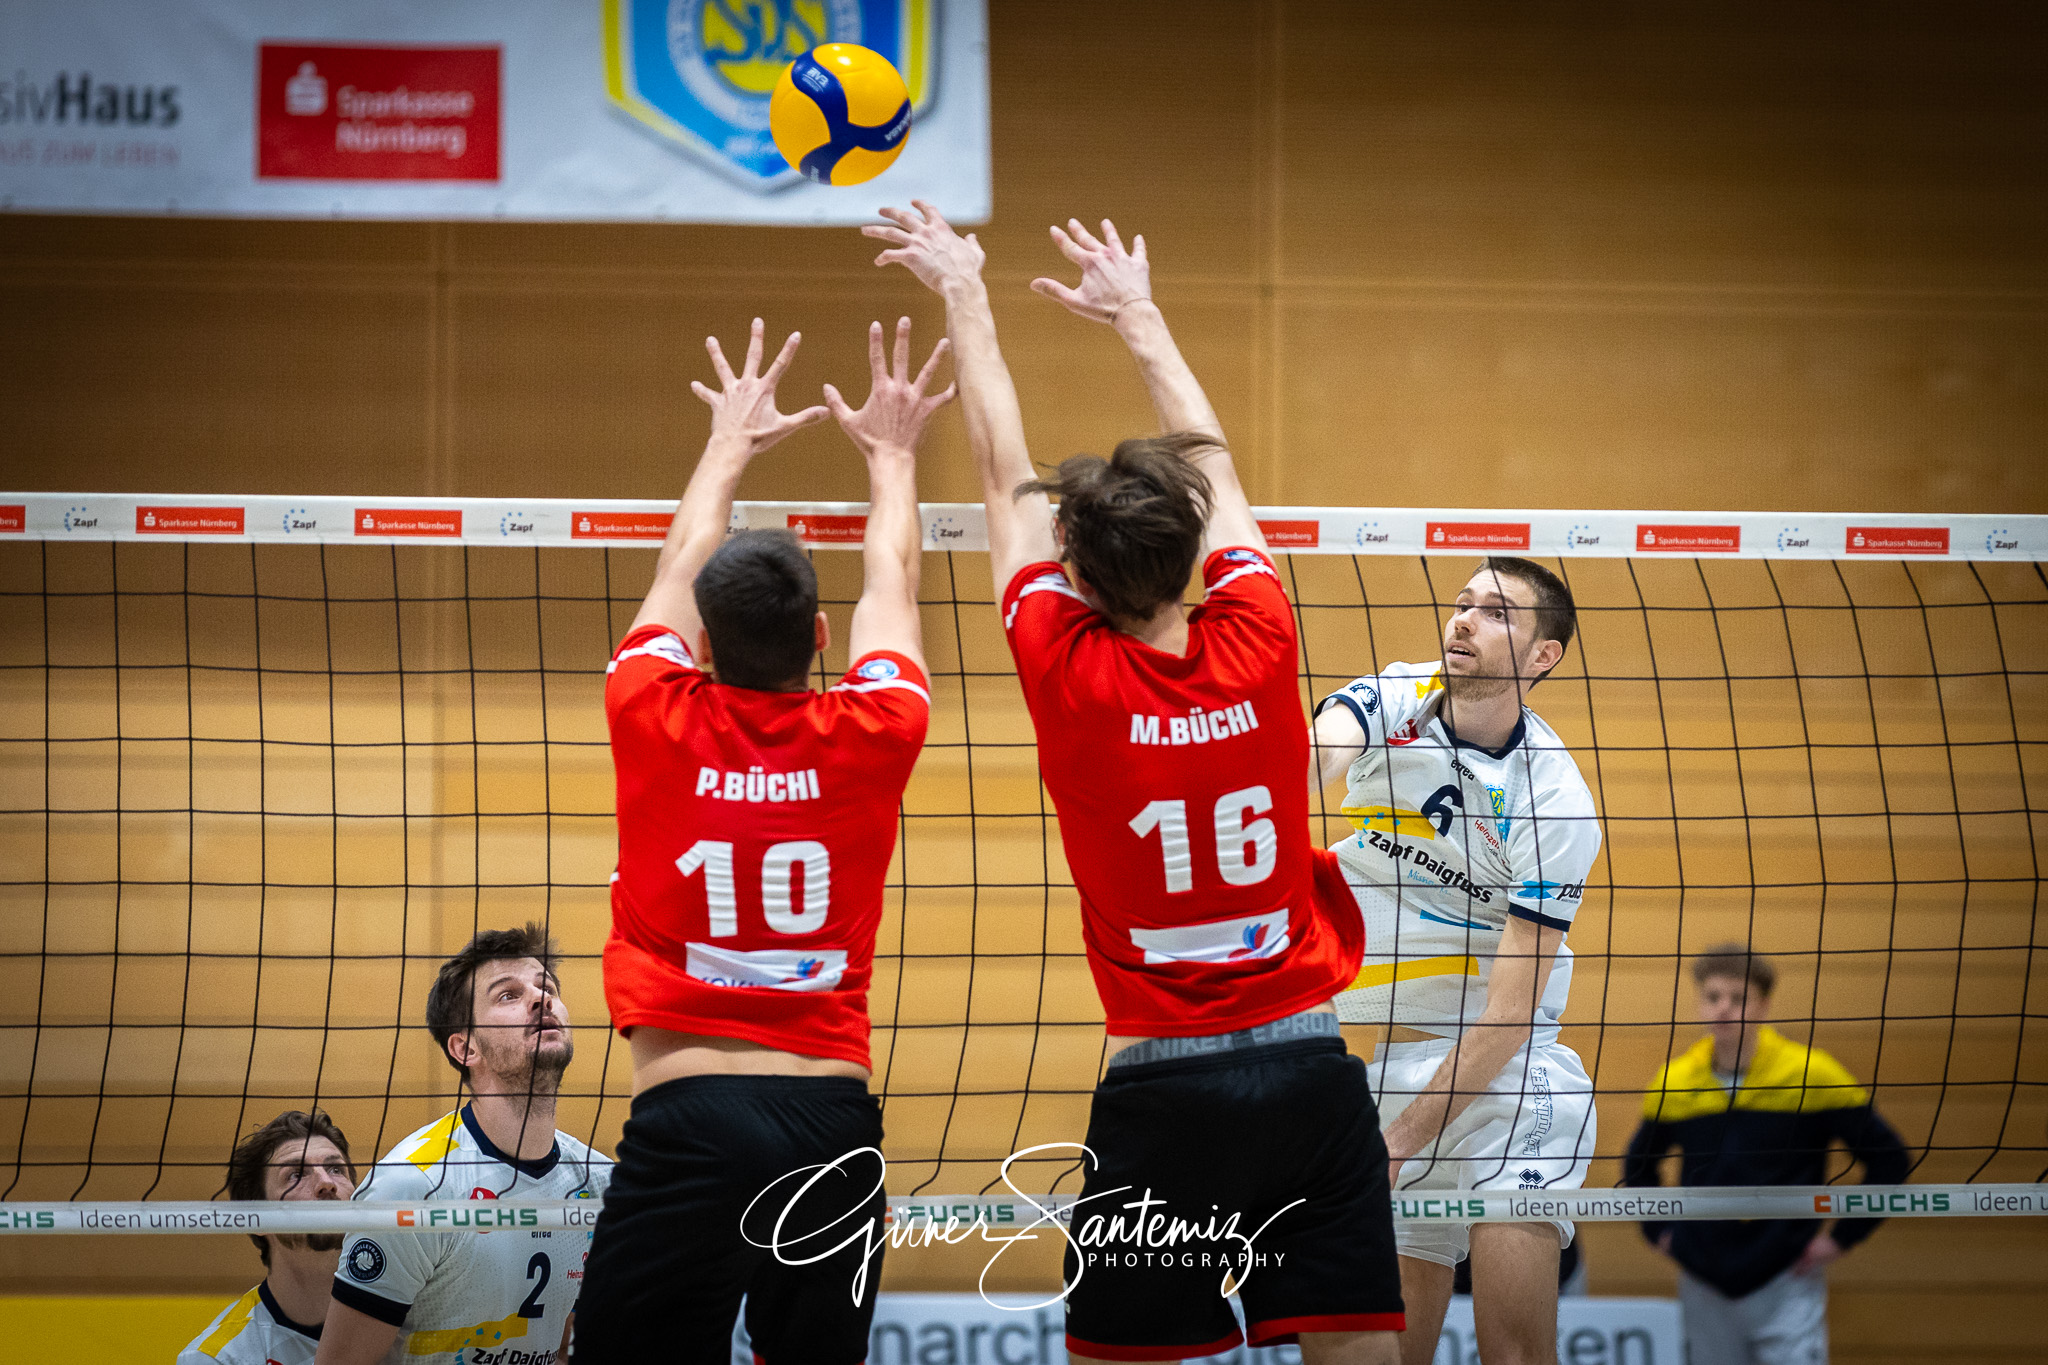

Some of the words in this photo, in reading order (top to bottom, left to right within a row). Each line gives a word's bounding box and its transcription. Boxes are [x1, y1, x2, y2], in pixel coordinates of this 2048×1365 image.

[73, 517, 98, 528] Zapf
[158, 518, 199, 528] Sparkasse
[200, 518, 238, 529] Nürnberg
[292, 519, 317, 530] Zapf
[377, 521, 416, 531] Sparkasse
[418, 521, 455, 531] Nürnberg
[510, 523, 534, 533] Zapf
[593, 524, 633, 533] Sparkasse
[940, 528, 964, 538] Zapf
[1275, 532, 1312, 541] Nürnberg
[1365, 533, 1389, 543] Zapf
[1448, 535, 1486, 544] Sparkasse
[1487, 535, 1523, 544] Nürnberg
[1576, 536, 1600, 545] Zapf
[1658, 537, 1697, 546] Sparkasse
[1698, 537, 1734, 546] Nürnberg
[1786, 539, 1810, 548] Zapf
[1868, 539, 1906, 548] Sparkasse
[1907, 539, 1943, 549] Nürnberg
[1995, 540, 2019, 550] Zapf
[1130, 700, 1259, 746] M.BÜCHI
[695, 766, 821, 803] P.BÜCHI
[1420, 784, 1464, 837] 6
[1128, 785, 1278, 894] 16
[1368, 831, 1414, 860] Zapf
[1414, 850, 1493, 903] Daigfuss
[675, 839, 831, 938] 10
[1510, 1197, 1568, 1217] Ideen
[1577, 1198, 1683, 1216] umsetzen
[1846, 1193, 1950, 1212] FUCHS
[1974, 1191, 2032, 1211] Ideen
[80, 1210, 141, 1228] Ideen
[150, 1209, 261, 1228] umsetzen
[430, 1209, 538, 1227] FUCHS
[908, 1204, 1015, 1223] FUCHS
[517, 1251, 551, 1318] 2
